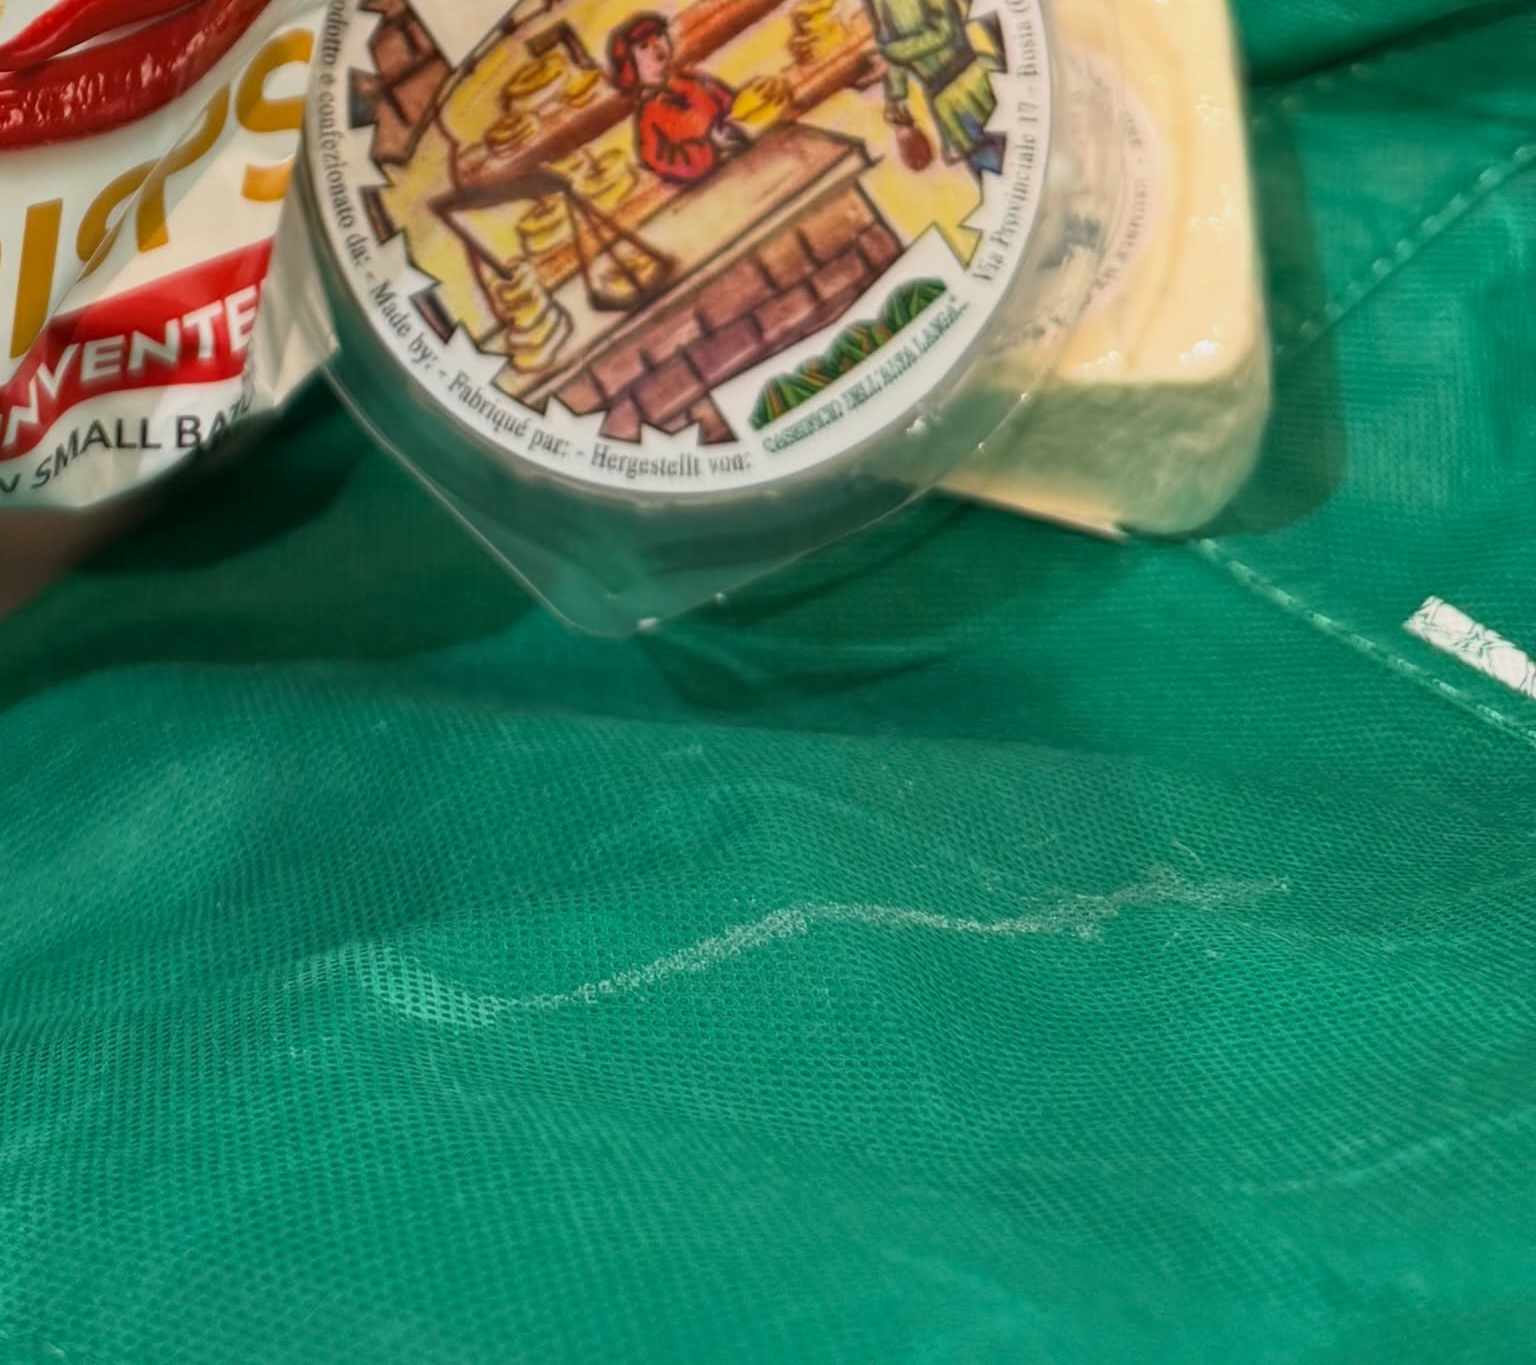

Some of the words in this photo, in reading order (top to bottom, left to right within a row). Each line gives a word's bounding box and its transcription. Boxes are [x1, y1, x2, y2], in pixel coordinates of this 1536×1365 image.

[318, 92, 356, 231] confezionato
[344, 232, 372, 269] da:
[370, 280, 414, 340] Made
[403, 331, 436, 375] by:
[447, 371, 529, 441] Fabriqué
[530, 429, 570, 461] par:
[589, 444, 703, 482] Hergestellt
[707, 452, 752, 477] von:
[30, 416, 162, 489] SMALL
